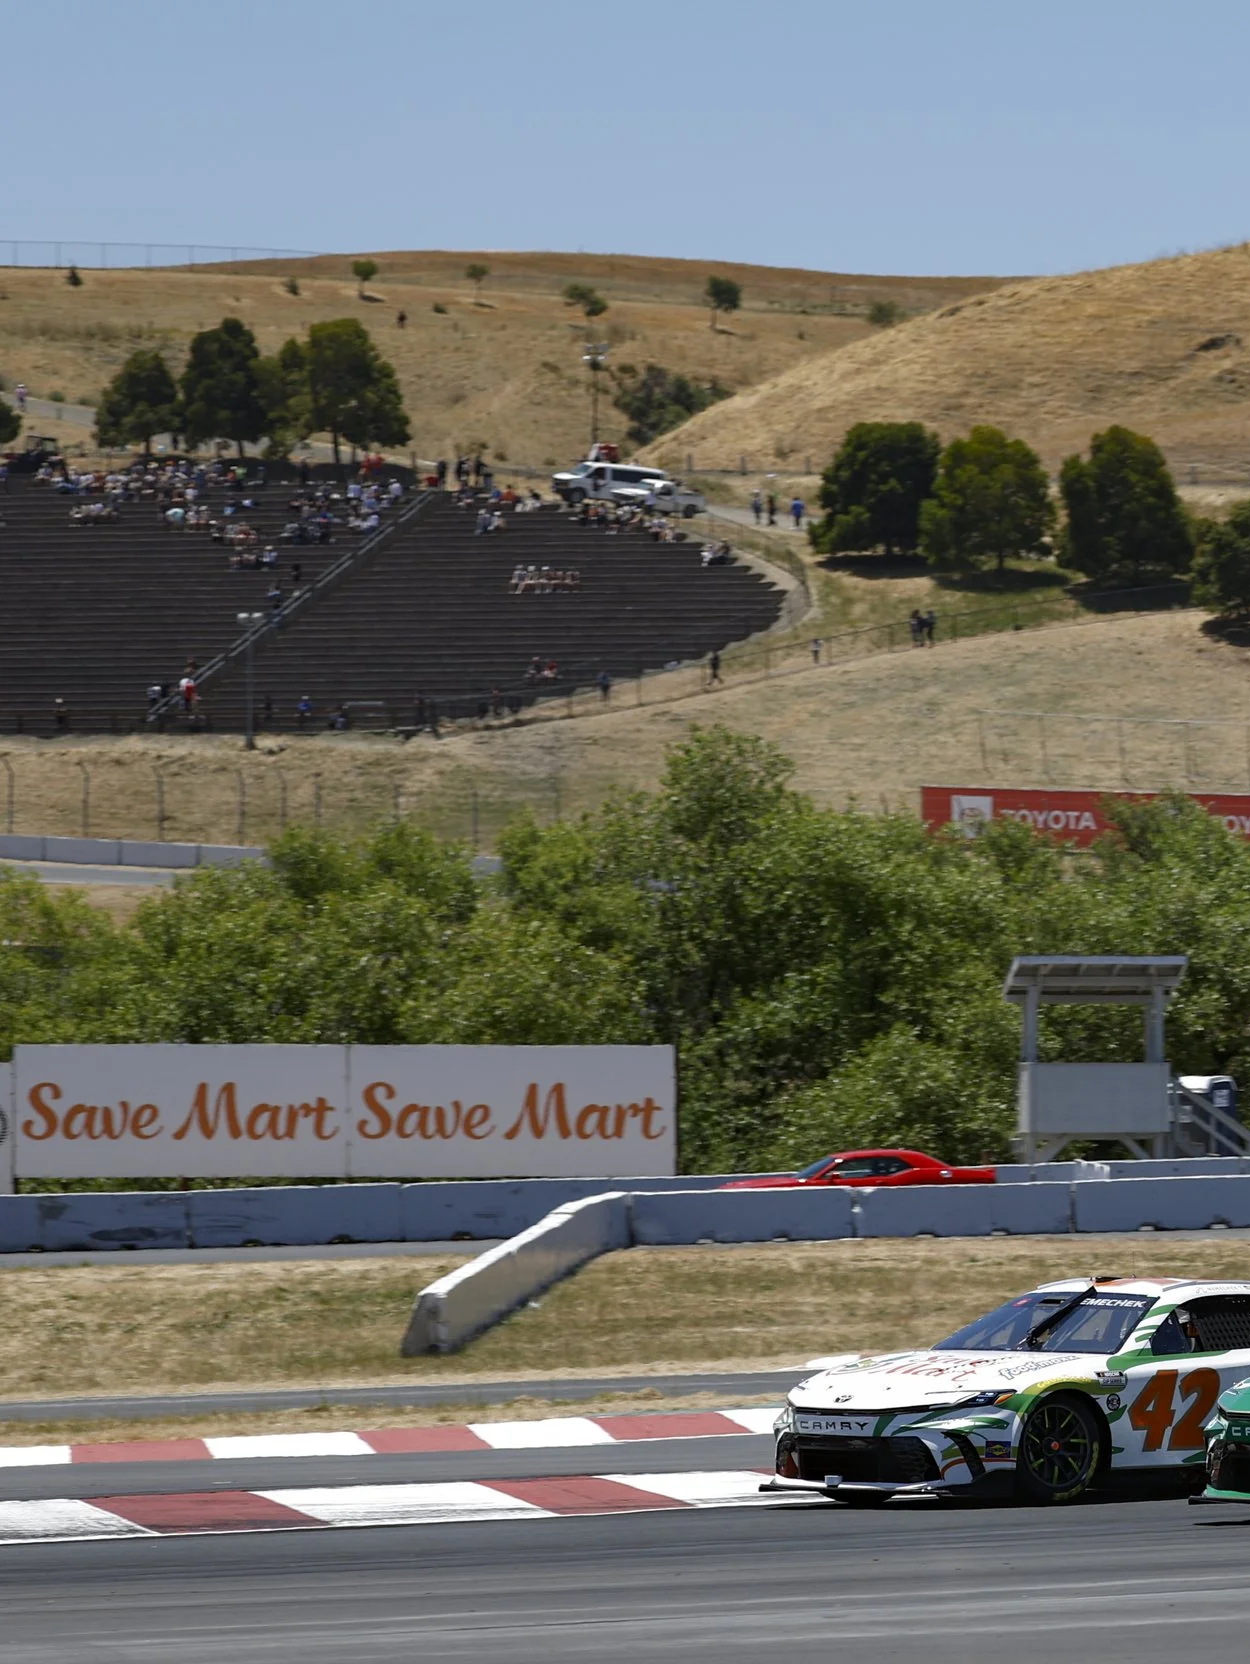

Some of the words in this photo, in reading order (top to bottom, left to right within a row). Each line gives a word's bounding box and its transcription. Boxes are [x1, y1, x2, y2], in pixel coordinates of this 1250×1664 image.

[22, 1082, 164, 1141] Save
[171, 1081, 339, 1141] Mart
[356, 1081, 497, 1141] Save
[502, 1082, 668, 1141] Mart
[1080, 1298, 1147, 1308] EMECHEK
[800, 1421, 869, 1430] CAMRY
[1127, 1367, 1220, 1452] 42
